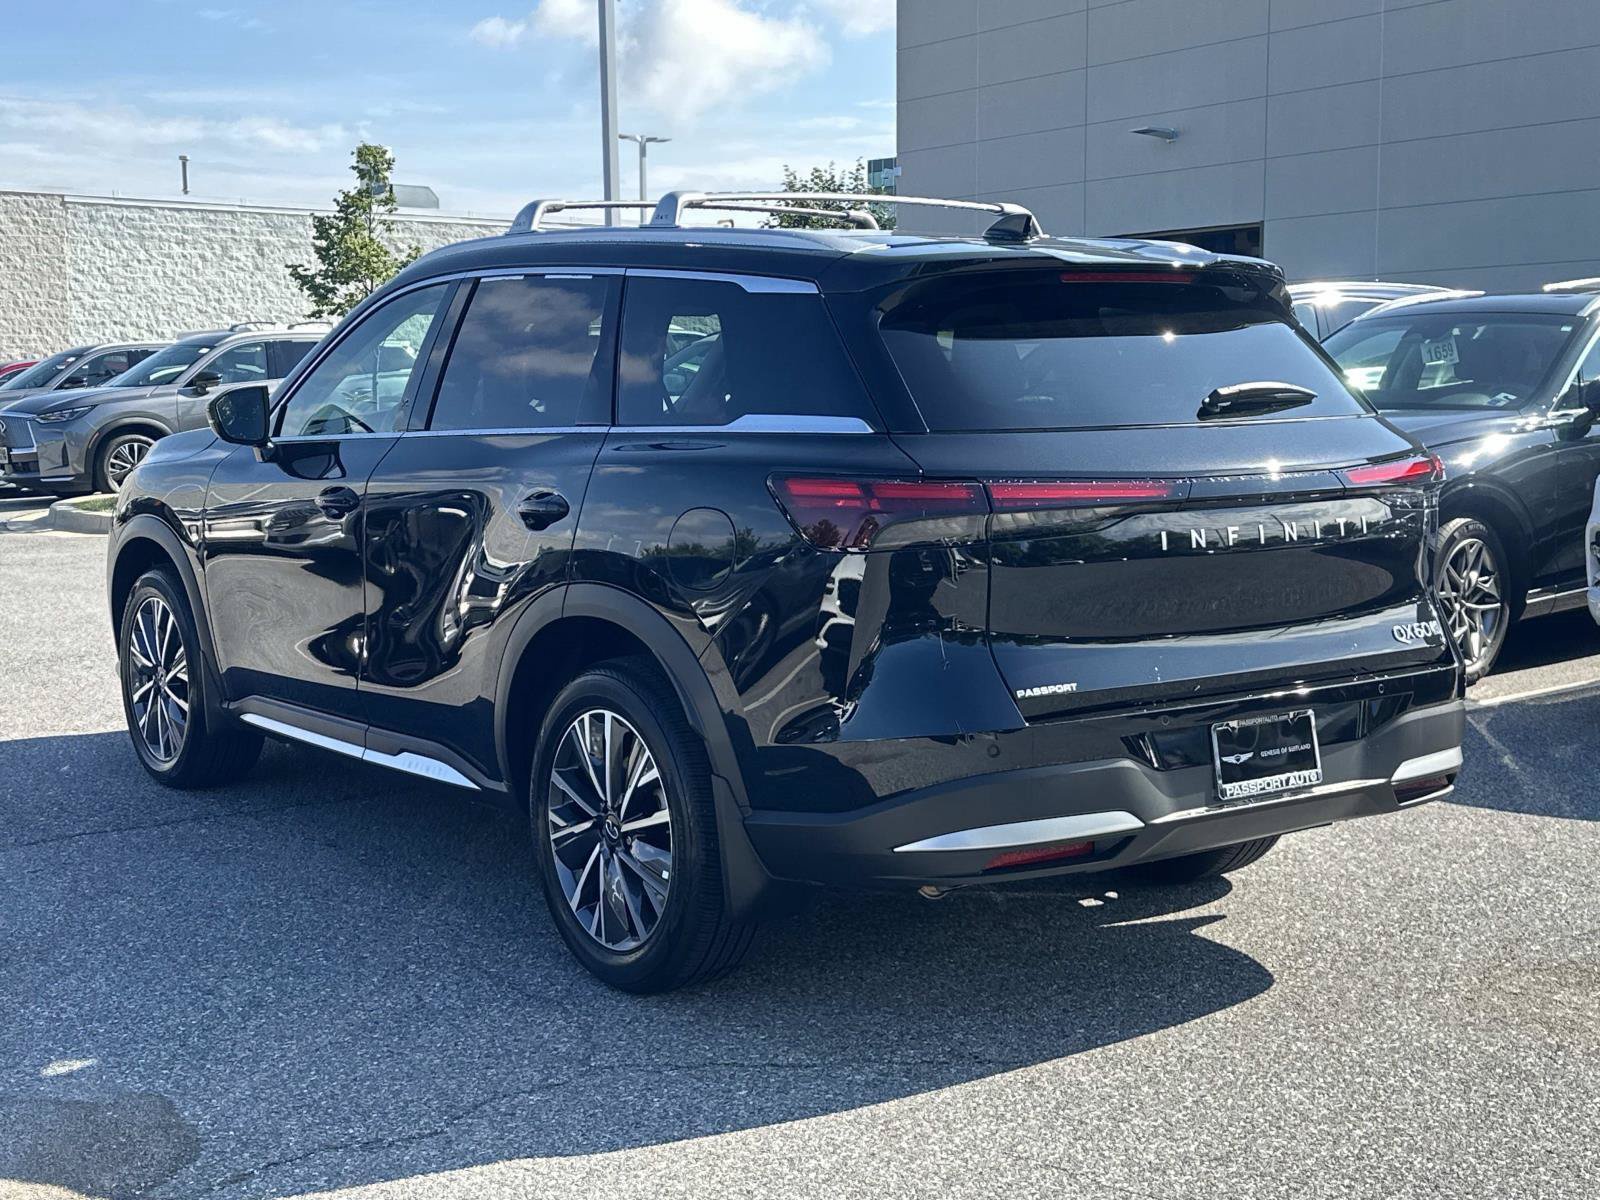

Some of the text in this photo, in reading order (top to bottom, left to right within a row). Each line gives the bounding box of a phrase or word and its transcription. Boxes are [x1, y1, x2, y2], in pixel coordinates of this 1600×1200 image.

[1426, 342, 1454, 361] 1659
[1160, 515, 1368, 551] INFINITI
[1016, 683, 1078, 699] PASSPORT
